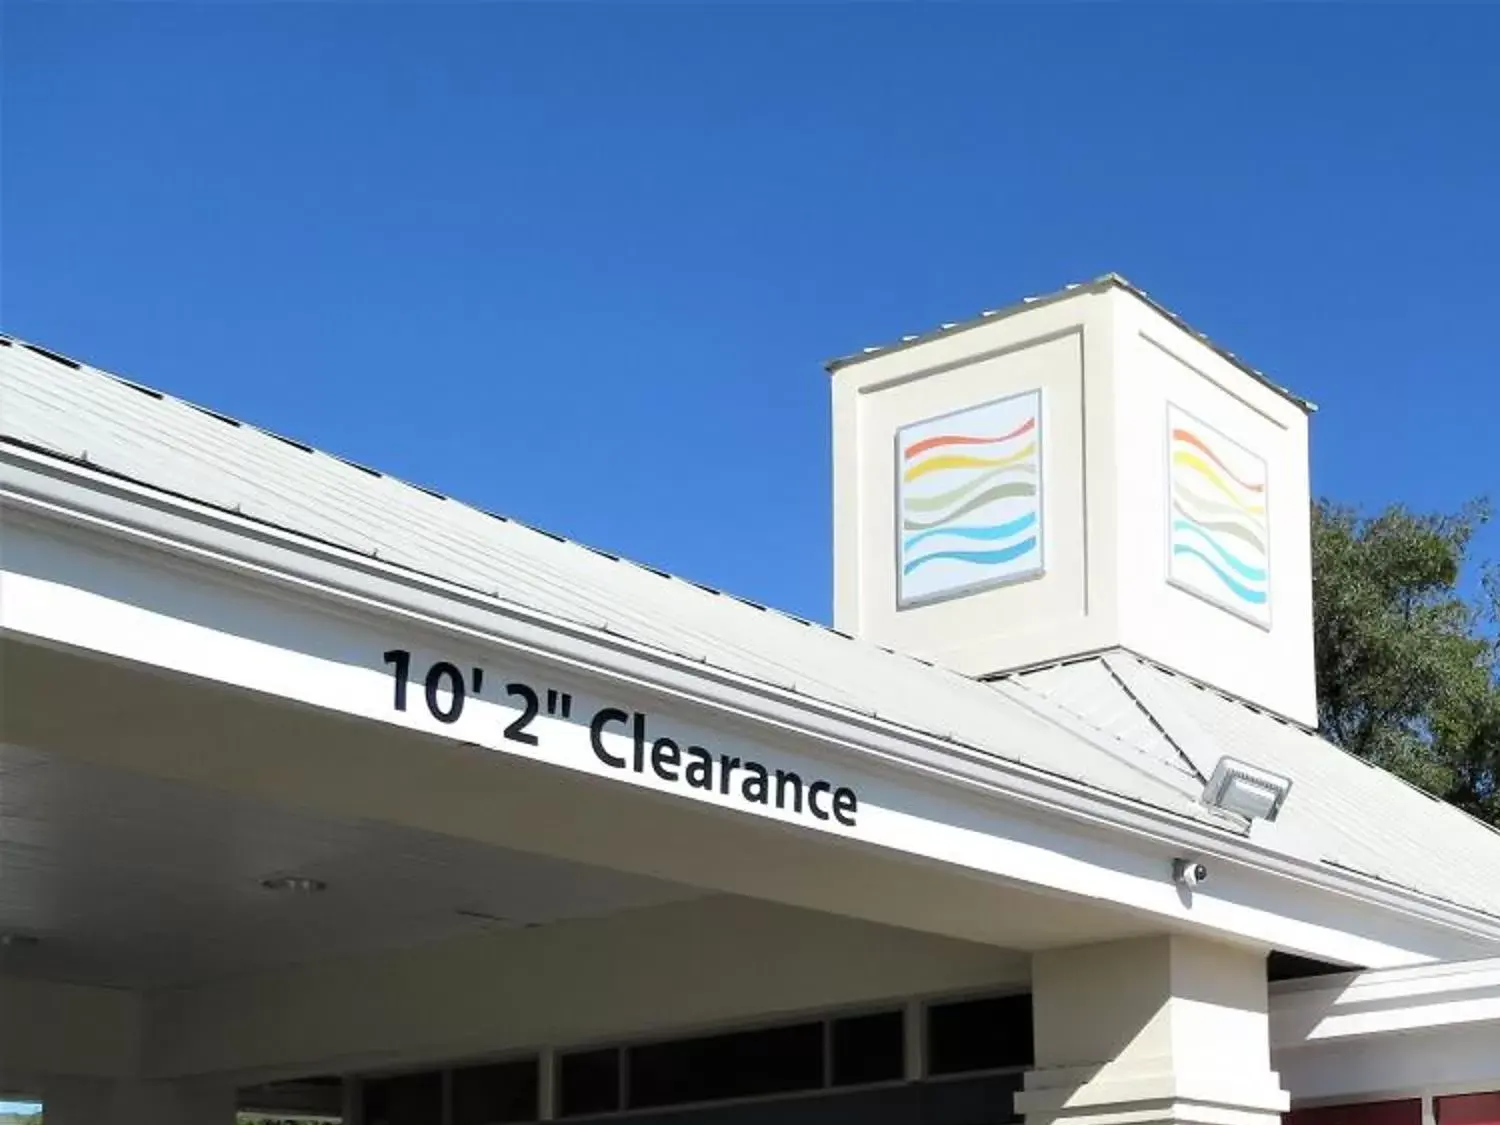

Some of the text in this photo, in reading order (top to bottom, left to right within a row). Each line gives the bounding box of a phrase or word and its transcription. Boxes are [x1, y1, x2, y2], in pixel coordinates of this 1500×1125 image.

[383, 649, 858, 827] 10' 2" Clearance
